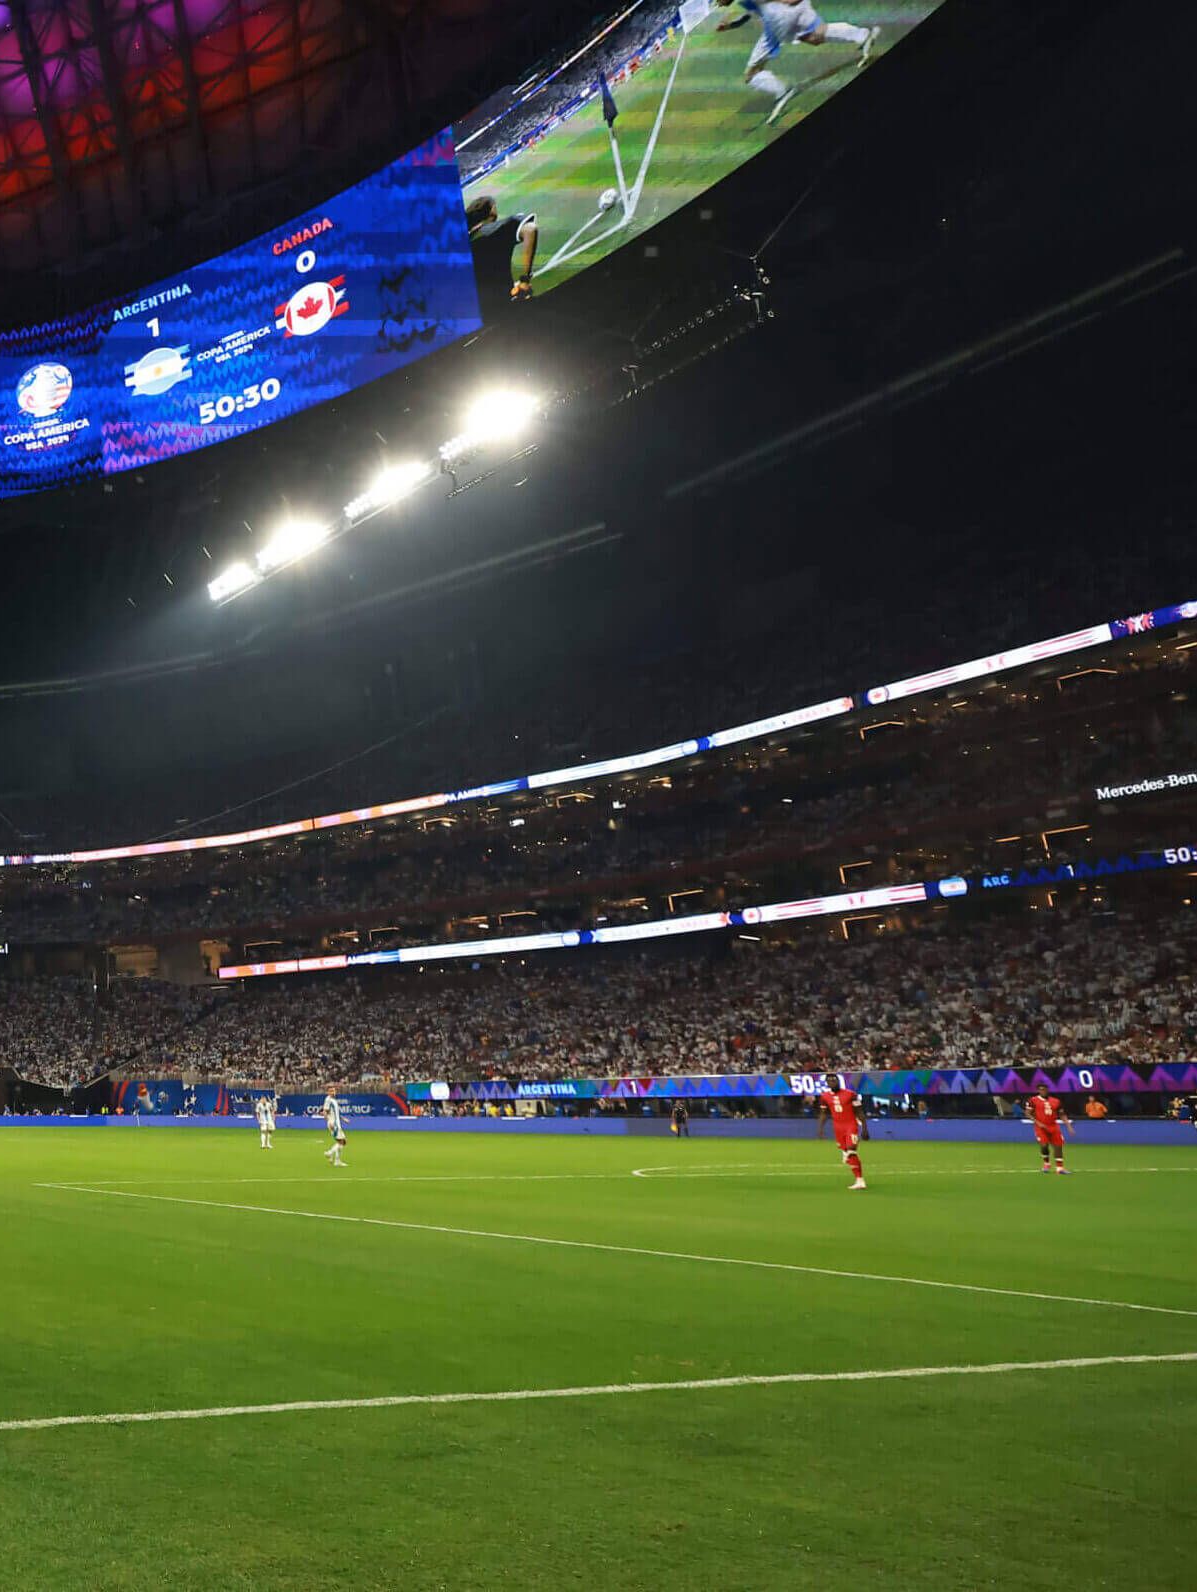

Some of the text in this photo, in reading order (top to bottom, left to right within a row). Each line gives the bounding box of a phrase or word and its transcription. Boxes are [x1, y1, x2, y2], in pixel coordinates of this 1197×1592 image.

[272, 218, 333, 256] CANADA
[295, 250, 316, 273] 0
[113, 283, 191, 322] ARGENTINA
[146, 317, 160, 337] 1
[196, 345, 224, 362] COPA
[225, 326, 271, 351] AMERICA
[199, 378, 281, 425] 50:30
[4, 432, 35, 445] COPA
[37, 418, 90, 439] AMERICA
[1096, 773, 1197, 800] Mercedes-Ben
[1066, 864, 1074, 877] 1
[517, 1083, 577, 1095] ARGENTINA
[630, 1080, 637, 1094] 1
[1079, 1069, 1094, 1089] 0
